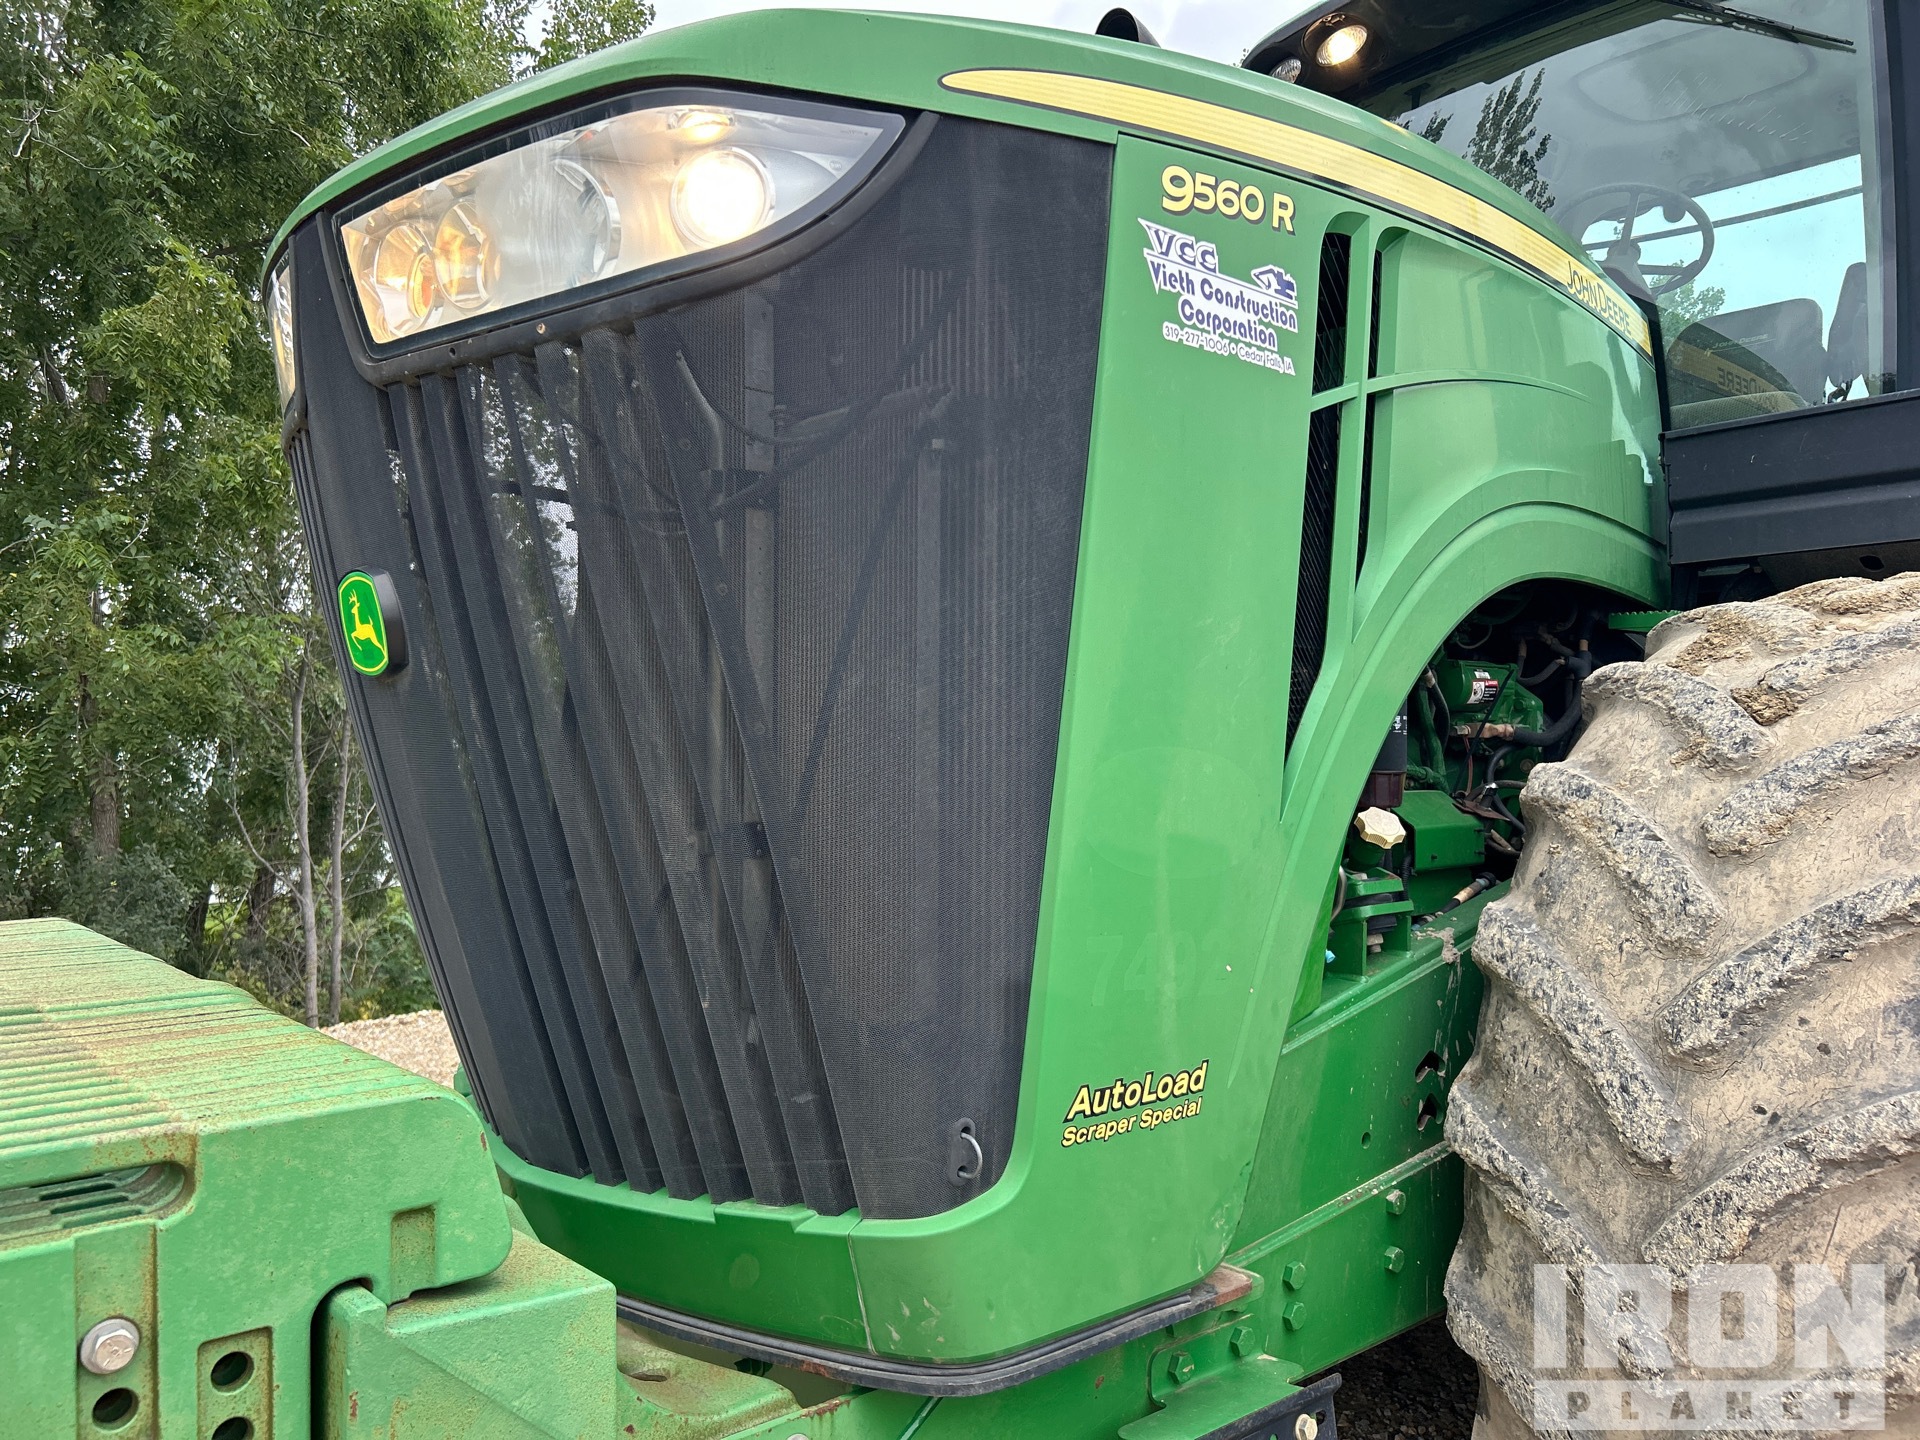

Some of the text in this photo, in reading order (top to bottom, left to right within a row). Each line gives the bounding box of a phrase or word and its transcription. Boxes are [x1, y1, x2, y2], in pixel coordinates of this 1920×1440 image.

[1161, 165, 1296, 236] 9560 R
[1145, 224, 1217, 273] VCC
[1150, 261, 1296, 330] Vieth Construction
[1180, 299, 1276, 348] Corporation
[1566, 260, 1632, 336] JOHN DEERE
[1165, 325, 1228, 353] 319-277-1006
[1239, 346, 1263, 362] Cedar
[1063, 1059, 1210, 1123] AutoLoad
[1061, 1096, 1203, 1147] Scraper Special
